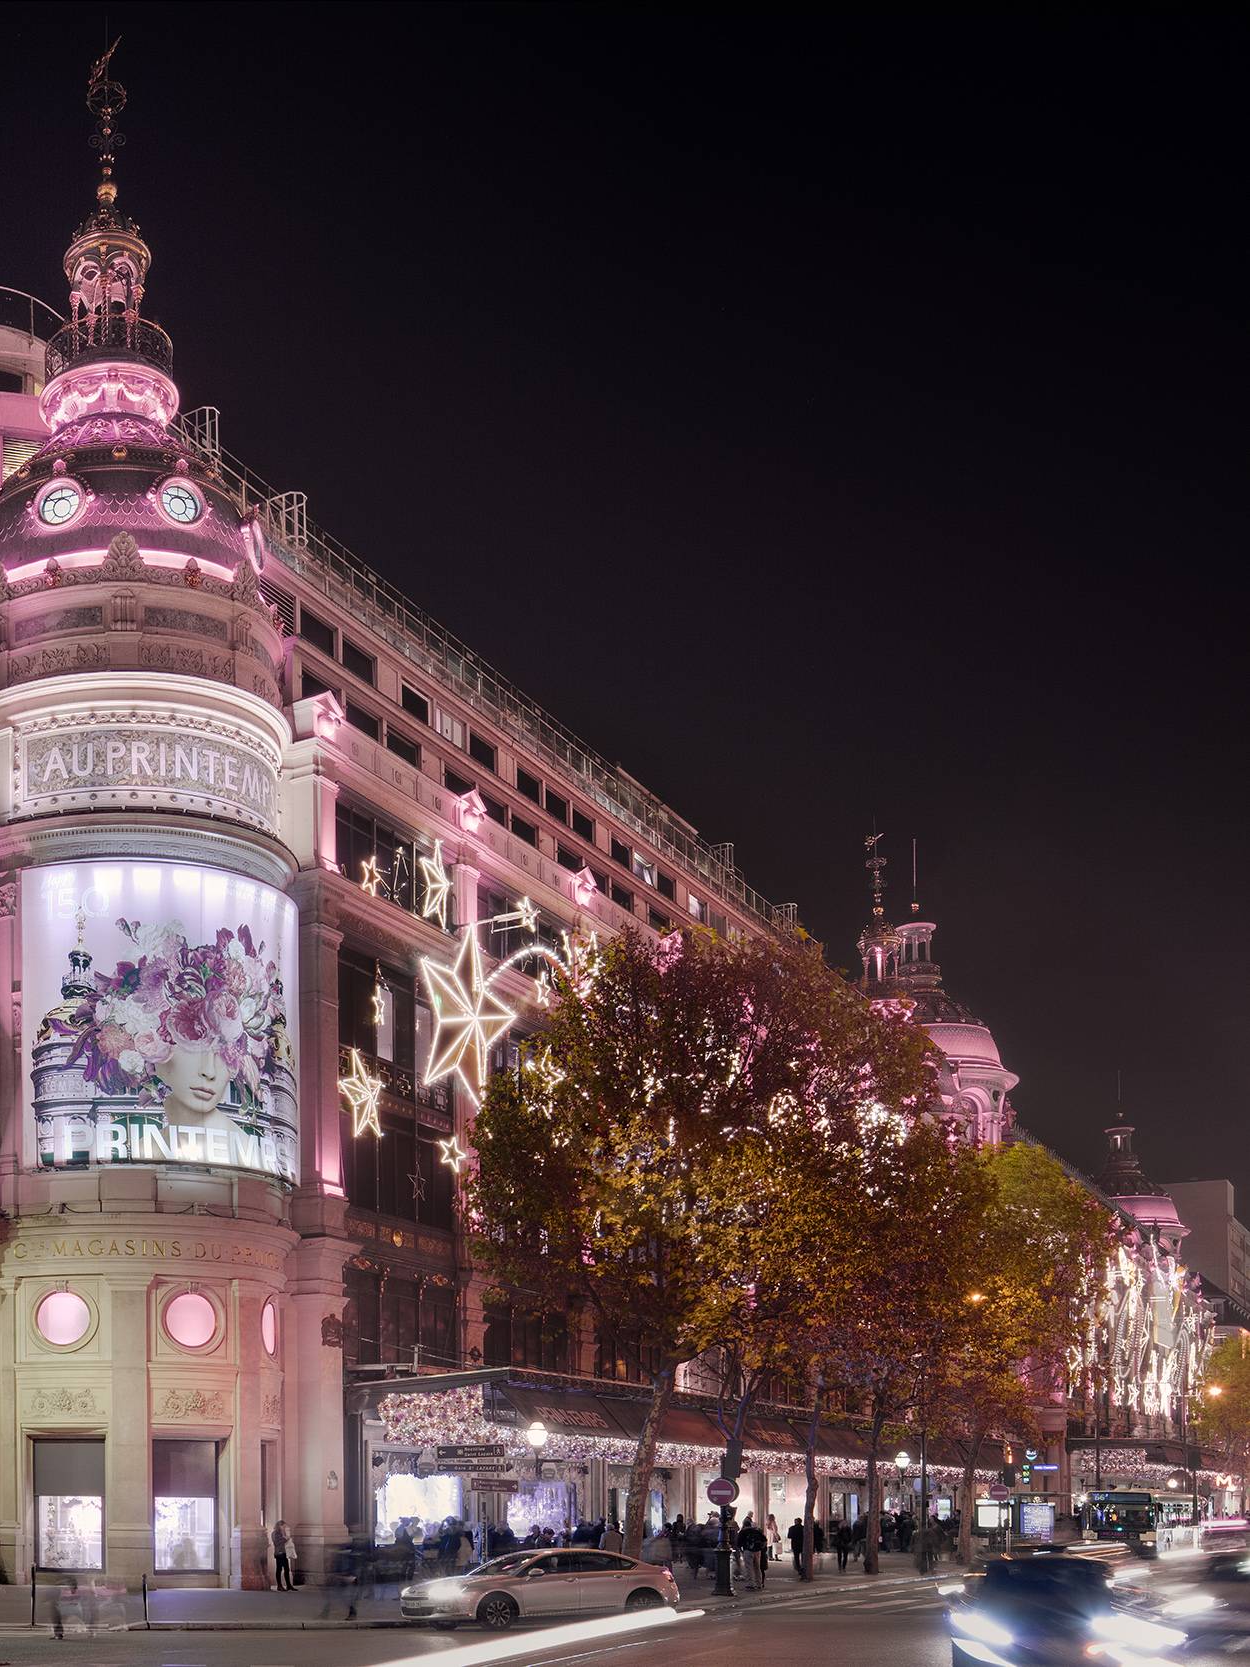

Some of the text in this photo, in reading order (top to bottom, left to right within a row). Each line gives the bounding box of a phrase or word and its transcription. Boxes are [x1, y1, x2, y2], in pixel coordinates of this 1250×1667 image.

[43, 743, 93, 782] AU
[55, 1122, 295, 1180] PRINTEMPS
[52, 1239, 182, 1258] MAGASINS
[194, 1242, 223, 1260] DU
